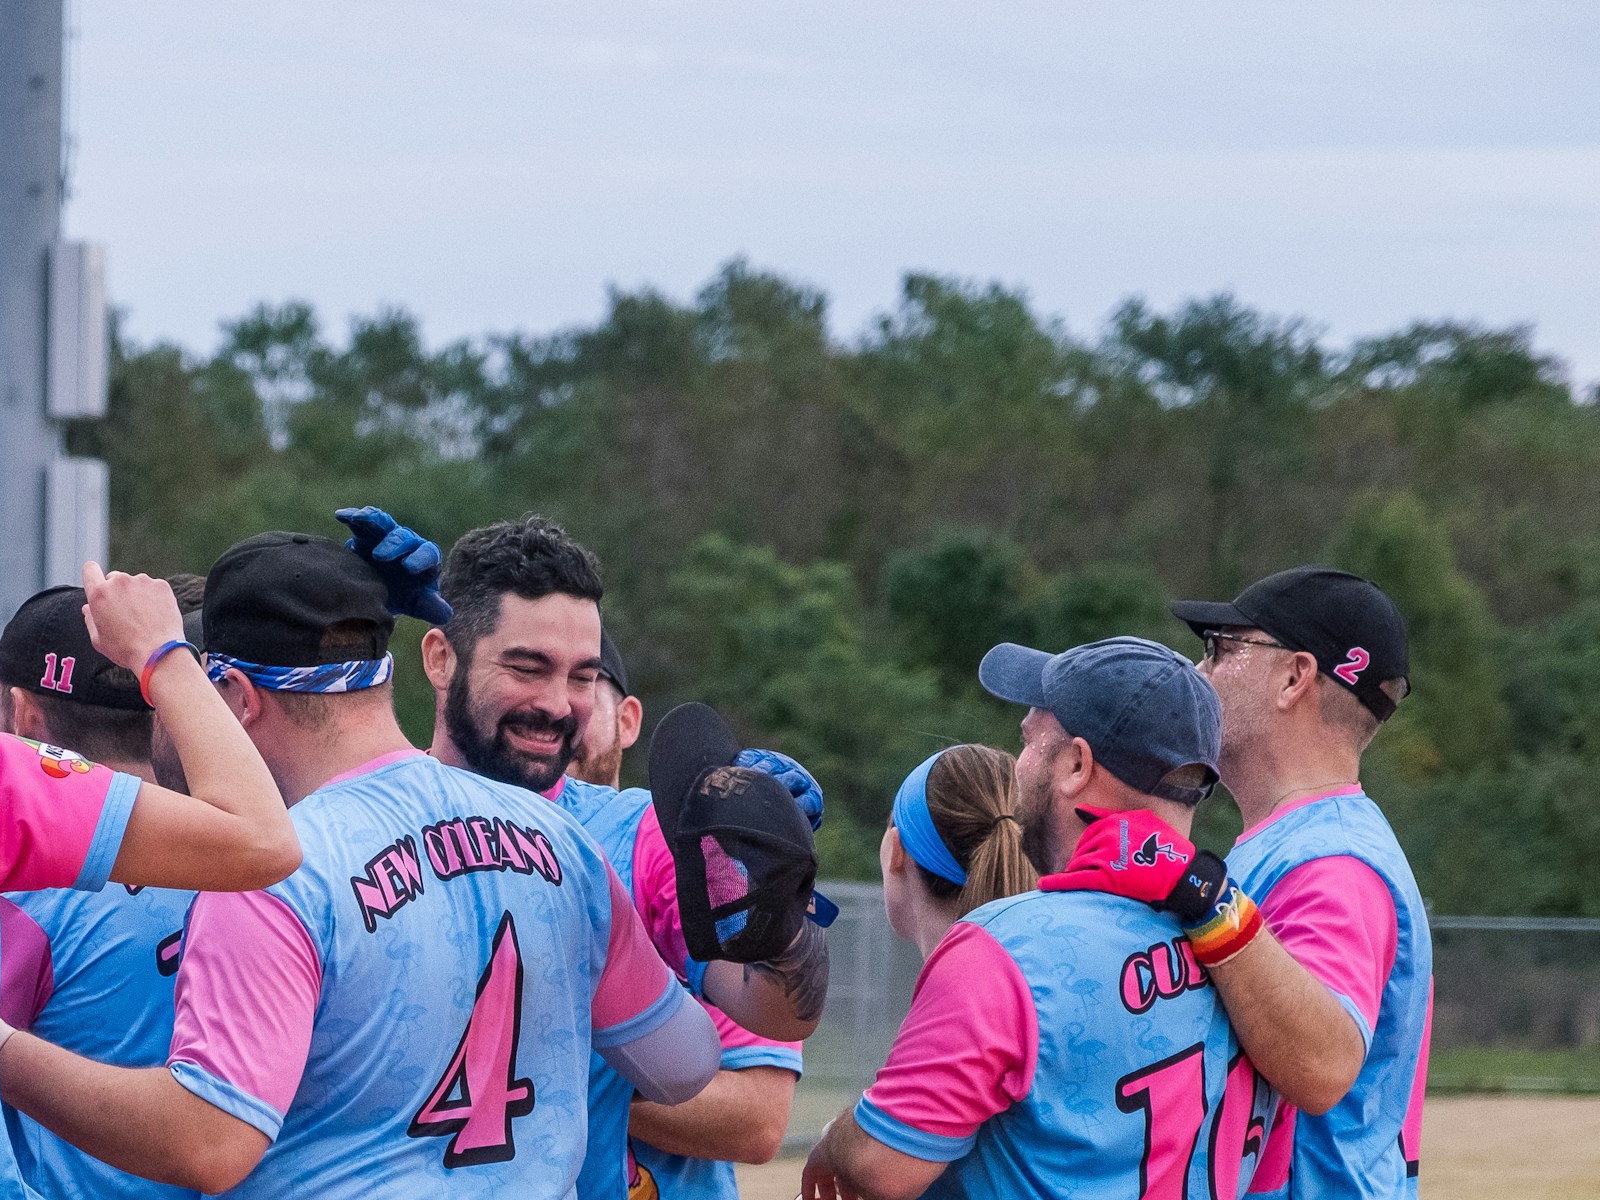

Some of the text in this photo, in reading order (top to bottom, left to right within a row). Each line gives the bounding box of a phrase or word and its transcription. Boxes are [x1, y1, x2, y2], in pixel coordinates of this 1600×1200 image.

[40, 652, 76, 693] 11
[1333, 646, 1370, 685] 2
[351, 816, 562, 933] NEW ORLEANS
[407, 910, 534, 1169] 4
